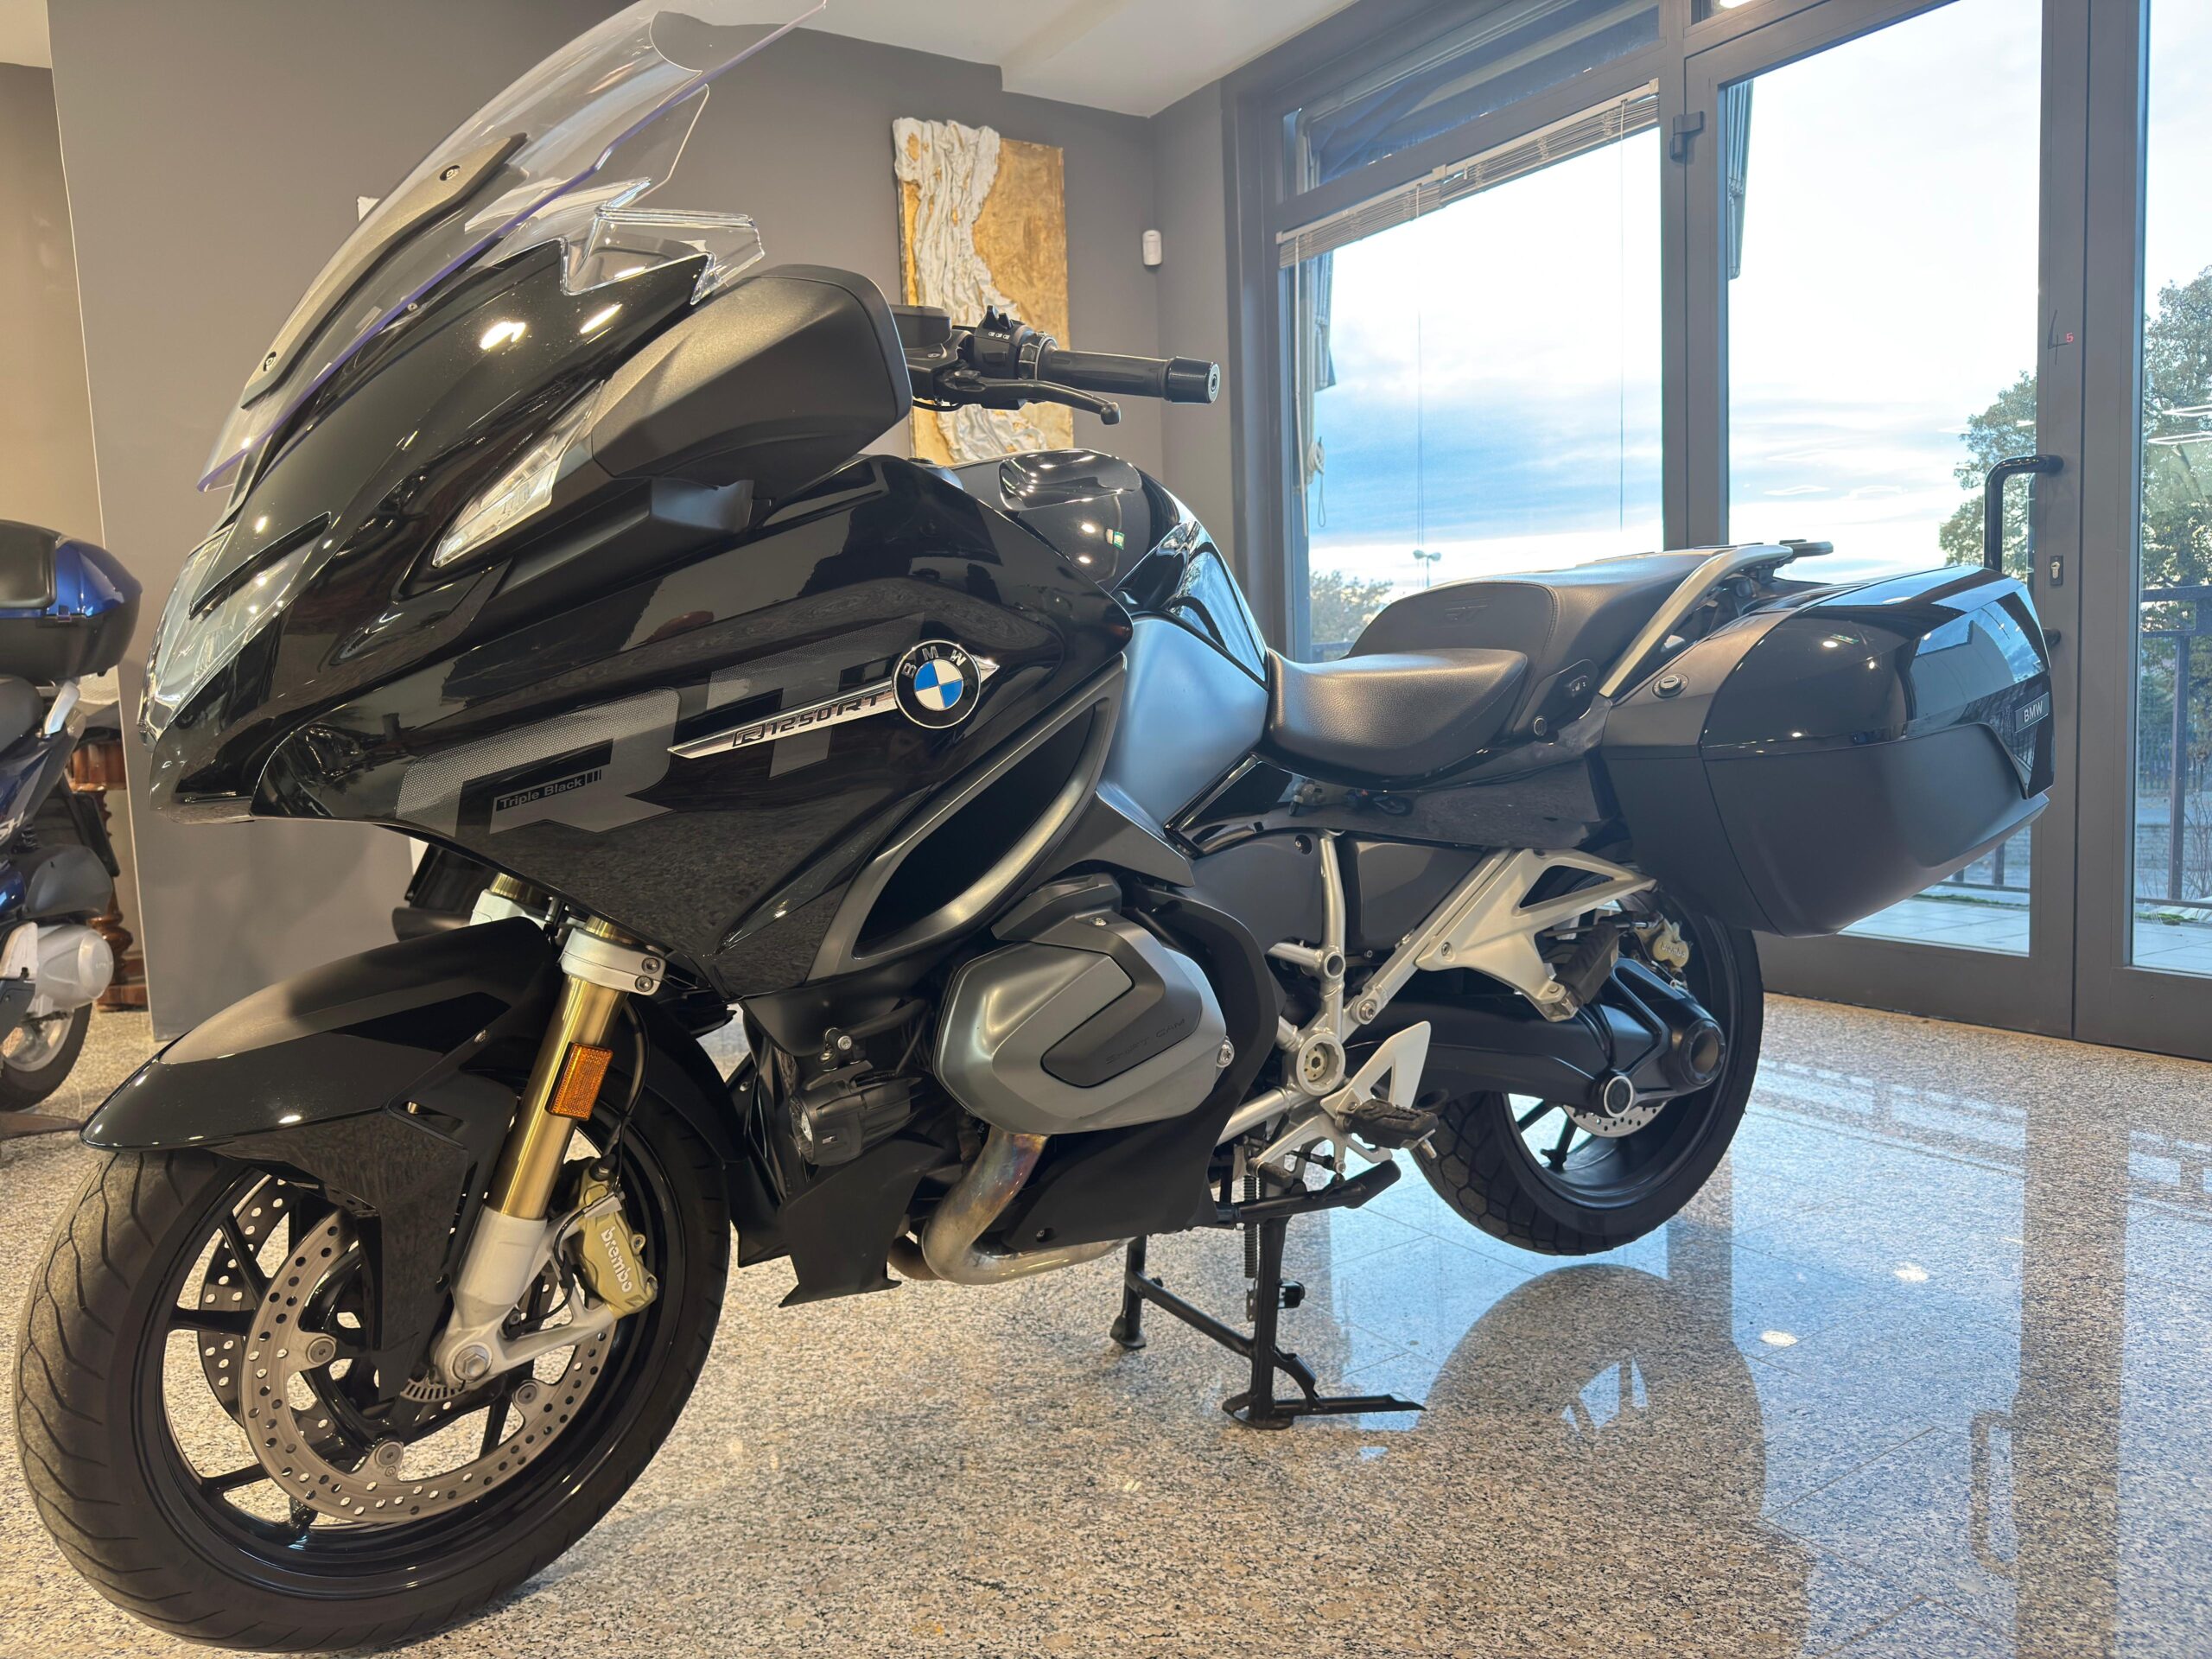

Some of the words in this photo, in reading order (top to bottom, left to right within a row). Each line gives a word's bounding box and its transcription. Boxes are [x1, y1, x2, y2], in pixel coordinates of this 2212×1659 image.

[901, 645, 967, 679] BMW
[2024, 700, 2043, 723] BMW
[499, 791, 540, 809] Triple
[543, 778, 583, 796] Black
[601, 1226, 632, 1293] brembo
